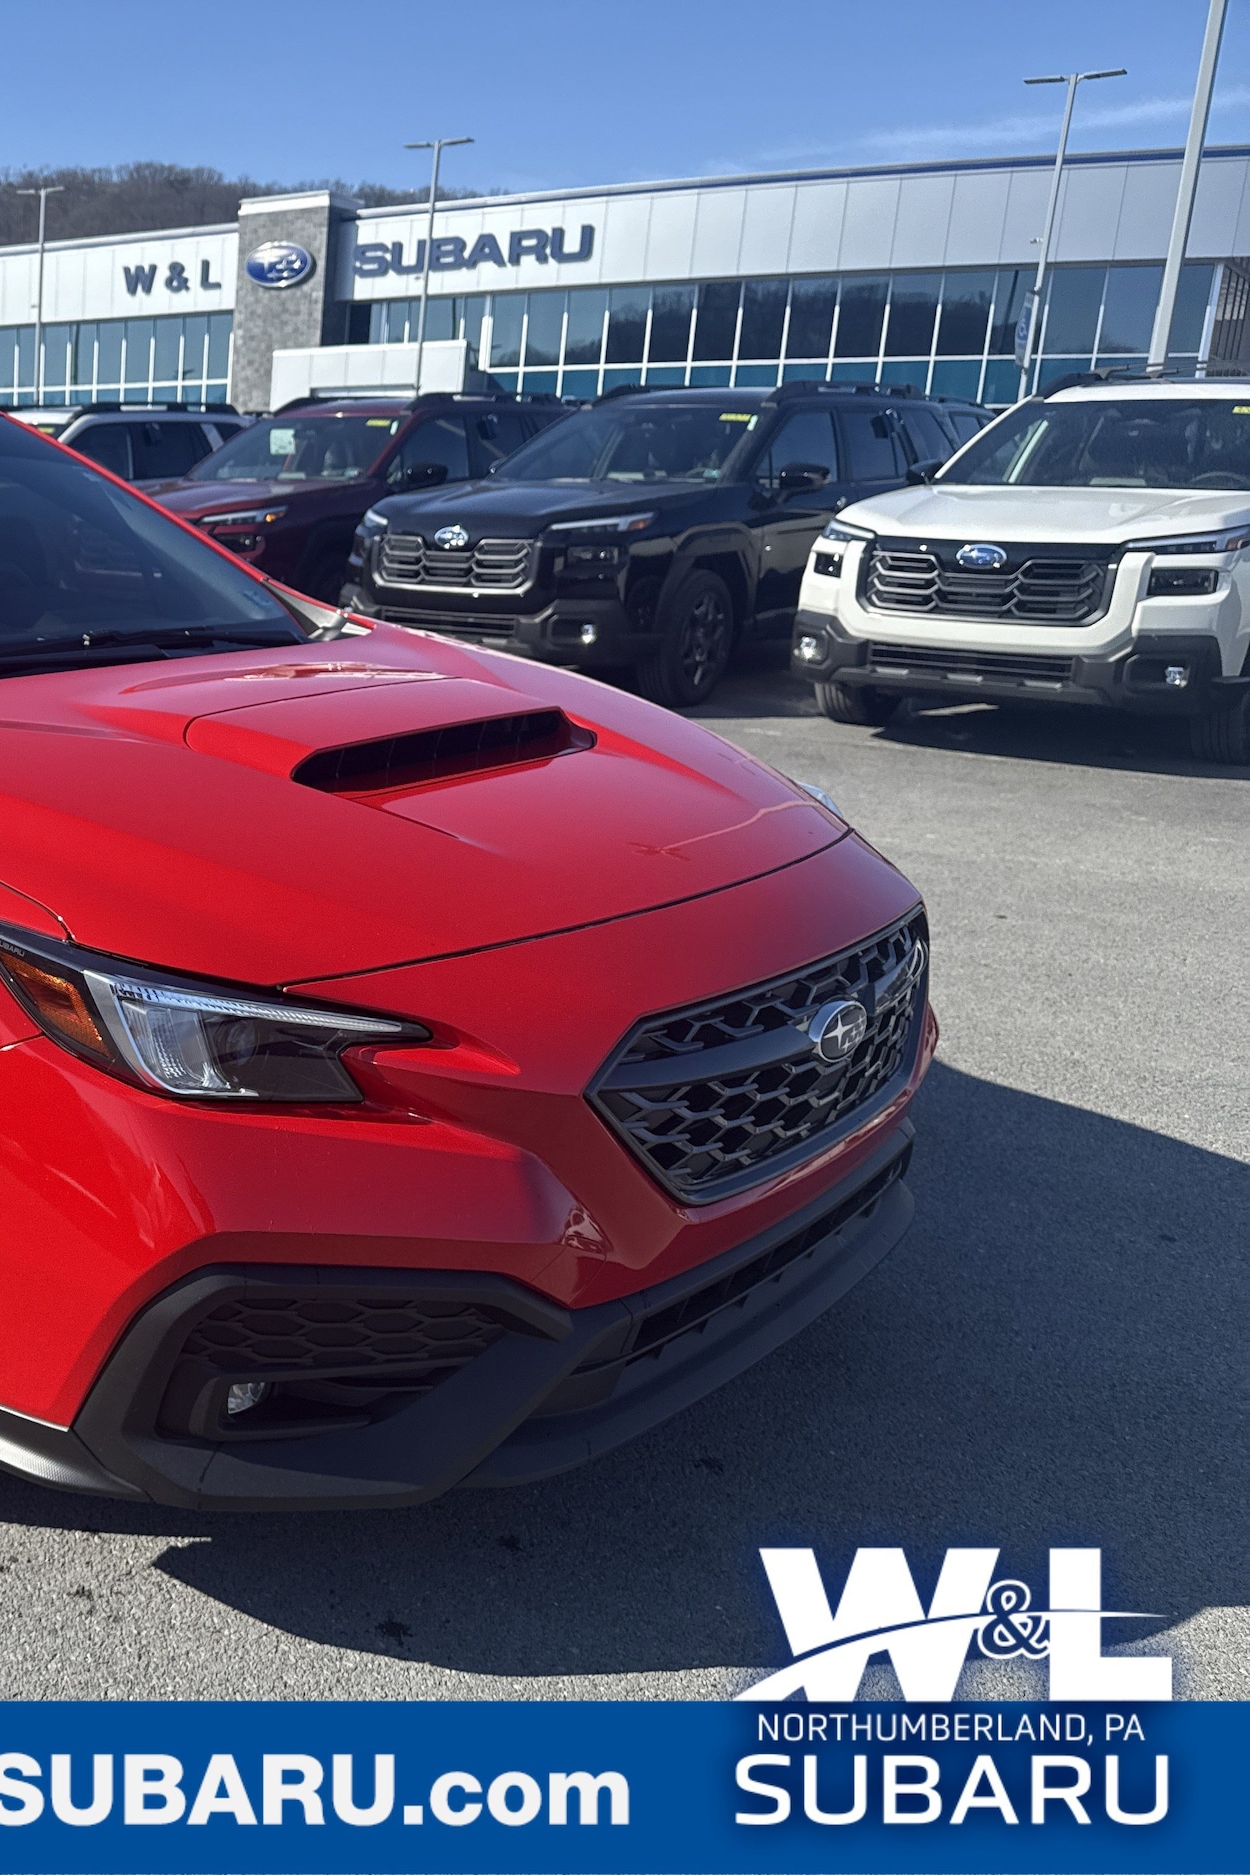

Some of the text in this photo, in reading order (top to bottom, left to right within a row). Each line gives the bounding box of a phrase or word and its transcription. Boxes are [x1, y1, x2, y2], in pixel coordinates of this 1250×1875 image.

[352, 224, 595, 278] SUBARU
[123, 259, 222, 296] W & L
